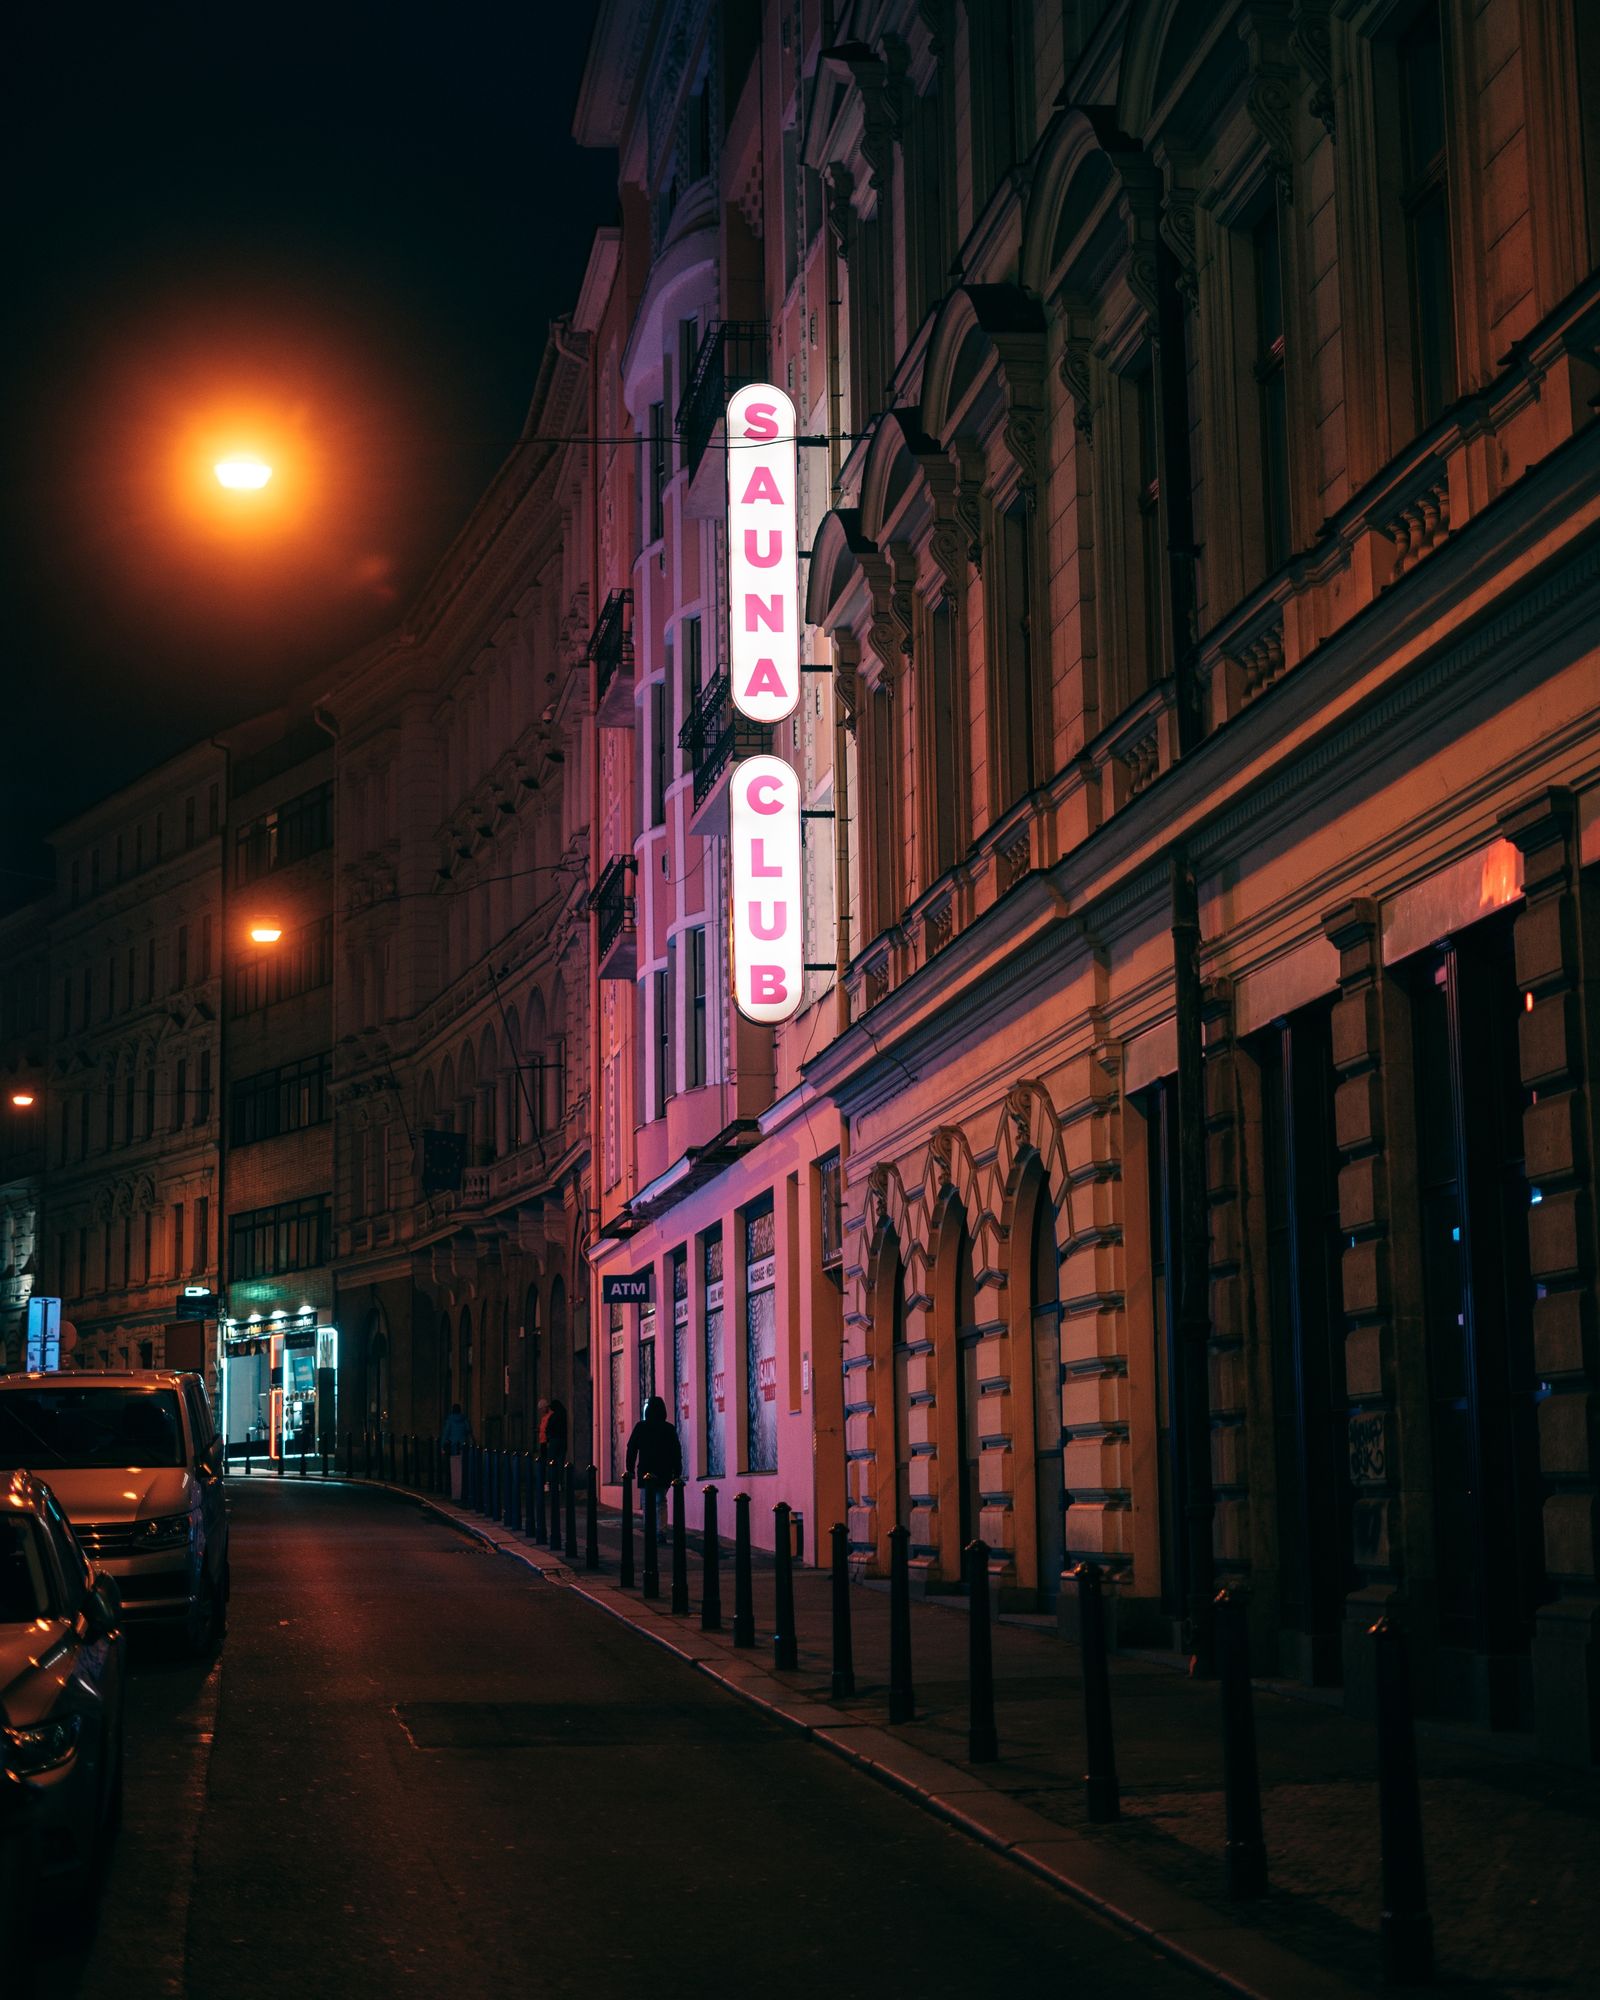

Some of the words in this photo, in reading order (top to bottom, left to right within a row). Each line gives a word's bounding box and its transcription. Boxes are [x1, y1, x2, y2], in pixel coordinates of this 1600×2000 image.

[741, 403, 788, 697] SAUNA
[746, 775, 788, 1005] CLUB
[610, 1282, 646, 1296] ATM
